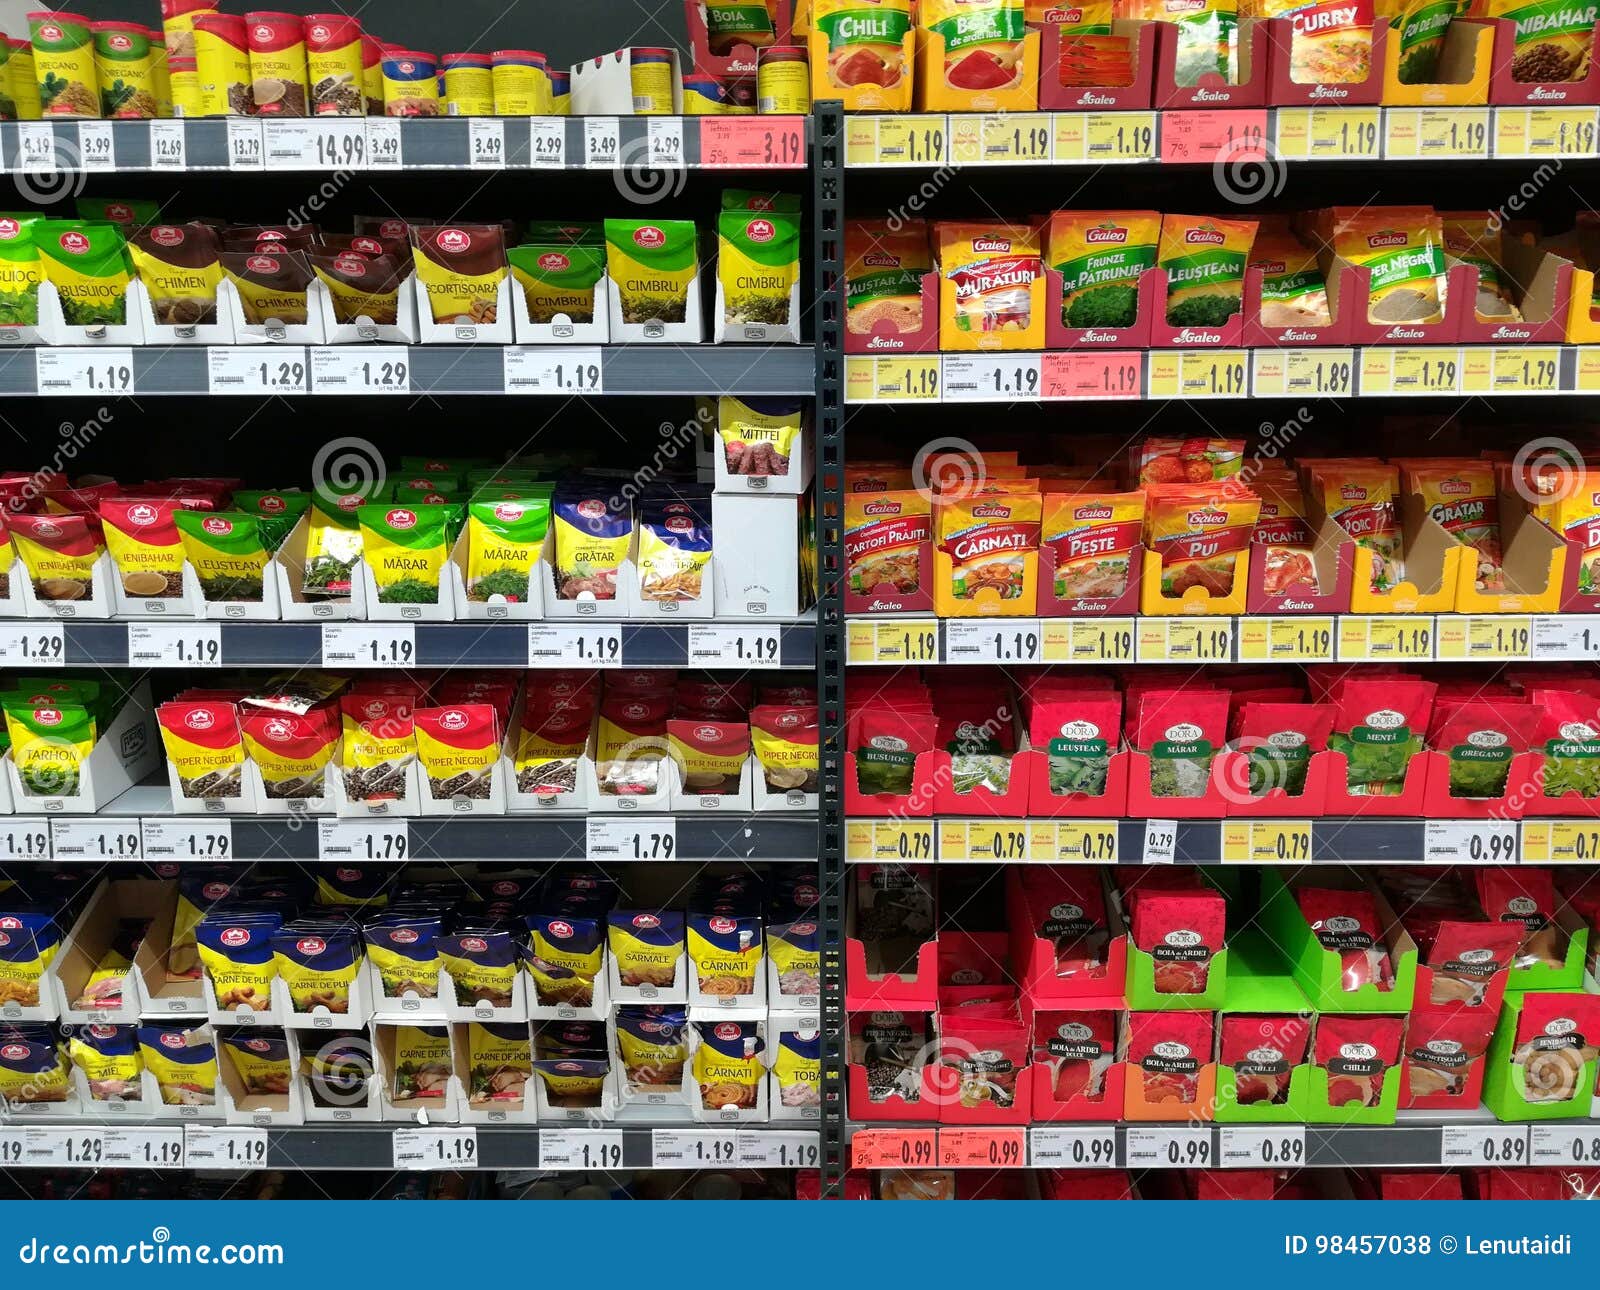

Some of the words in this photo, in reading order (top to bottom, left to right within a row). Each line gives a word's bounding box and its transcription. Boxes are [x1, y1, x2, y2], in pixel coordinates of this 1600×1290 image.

[713, 10, 744, 22] BOIA
[1047, 11, 1080, 23] Galeo
[1292, 7, 1358, 34] CURRY
[1515, 7, 1599, 37] NIBAHAR
[839, 17, 887, 37] CHILI
[85, 138, 110, 153] 3.99
[372, 138, 398, 154] 3.49
[475, 138, 501, 154] 3.49
[535, 138, 561, 154] 2.99
[590, 138, 616, 153] 3.49
[654, 137, 679, 153] 2.99
[908, 130, 942, 162] 1.19
[1013, 128, 1048, 155] 1.19
[1117, 127, 1151, 154] 1.19
[1227, 125, 1261, 152] 1.19
[1341, 122, 1376, 154] 1.19
[1451, 122, 1484, 150] 1.19
[1560, 121, 1595, 153] 1.19
[156, 138, 181, 155] 12.69
[234, 138, 259, 155] 13.79
[316, 134, 364, 165] 14.99
[710, 150, 728, 163] 5%
[764, 132, 799, 163] 3.19
[1171, 143, 1189, 157] 7%
[1088, 230, 1126, 242] Galeo
[1188, 231, 1224, 243] Galeo
[1370, 234, 1406, 245] Galeo
[974, 241, 1010, 252] Galeo
[1087, 253, 1125, 270] FRUNZE
[60, 285, 121, 298] BUSUIOC
[156, 277, 206, 290] CHIMEN
[627, 280, 679, 292] CIMBRU
[736, 276, 785, 290] CIMBRU
[847, 276, 896, 297] MUSTAR
[1064, 279, 1076, 291] DE
[255, 298, 305, 310] CHIMEN
[535, 296, 588, 307] CIMBRU
[877, 338, 904, 349] Galeo
[1186, 332, 1220, 343] Galeo
[87, 366, 131, 389] 1.19
[260, 362, 304, 386] 1.29
[362, 362, 407, 385] 1.29
[555, 364, 600, 388] 1.19
[905, 368, 938, 394] 1.19
[993, 367, 1038, 391] 1.19
[1104, 366, 1136, 391] 1.19
[1211, 364, 1244, 393] 1.19
[1316, 362, 1350, 392] 1.89
[1423, 361, 1456, 386] 1.79
[1522, 360, 1556, 386] 1.79
[1050, 383, 1067, 396] 7%
[740, 428, 780, 441] MITITEI
[866, 503, 900, 514] Galeo
[974, 507, 1009, 518] Galeo
[1076, 508, 1112, 519] Galeo
[1189, 513, 1227, 524] Galeo
[1345, 517, 1371, 534] PORC
[845, 537, 887, 557] CARTOFI
[956, 533, 1028, 560] CÂRNAȚI
[1071, 537, 1116, 558] PEȘTE
[1258, 531, 1304, 544] PICANT
[124, 552, 174, 564] IENIBAHAR
[484, 546, 528, 561] MĂRAR
[1189, 541, 1218, 558] PUI
[384, 556, 428, 570] MĂRAR
[21, 635, 62, 657] 1.29
[176, 639, 219, 661] 1.19
[370, 639, 413, 661] 1.19
[576, 636, 619, 659] 1.19
[735, 636, 778, 659] 1.19
[904, 632, 935, 660] 1.19
[994, 632, 1038, 659] 1.19
[1099, 631, 1131, 659] 1.19
[1196, 630, 1228, 658] 1.19
[1298, 629, 1330, 653] 1.19
[1398, 629, 1429, 653] 1.19
[1497, 628, 1529, 652] 1.19
[27, 749, 78, 761] TARHON
[763, 750, 787, 760] PIPER
[789, 750, 819, 761] NEGRU
[866, 752, 909, 763] BUSUIOC
[1057, 743, 1101, 755] LEUȘTEAN
[1166, 744, 1198, 754] MĂRAR
[1460, 750, 1504, 759] OREGANO
[203, 754, 237, 766] NEGRU
[454, 756, 487, 767] NEGRU
[706, 759, 740, 769] NEGRU
[7, 833, 47, 855] 1.19
[98, 834, 138, 855] 1.19
[188, 834, 229, 855] 1.79
[365, 833, 407, 859] 1.79
[632, 833, 674, 859] 1.79
[900, 832, 930, 859] 0.79
[993, 831, 1025, 858] 0.79
[1083, 832, 1115, 859] 0.79
[1148, 832, 1173, 848] 0.79
[1277, 832, 1309, 860] 0.79
[1470, 834, 1515, 860] 0.99
[1576, 832, 1600, 859] 0.7
[1156, 949, 1175, 957] BOIA
[1182, 949, 1207, 957] ARDEI
[242, 976, 253, 985] DE
[254, 975, 269, 985] PUI
[332, 981, 348, 990] PUI
[400, 1049, 427, 1059] CARNE
[428, 1050, 440, 1059] DE
[473, 1052, 500, 1062] CARNE
[501, 1052, 512, 1062] DE
[1051, 1043, 1068, 1053] BOIA
[1075, 1046, 1099, 1055] ARDEI
[1146, 1059, 1163, 1068] BOIA
[1171, 1061, 1195, 1070] ARDEI
[1343, 1063, 1371, 1073] CHILLI
[66, 1138, 101, 1161] 1.29
[144, 1143, 181, 1162] 1.19
[227, 1140, 265, 1160] 1.19
[436, 1138, 475, 1159] 1.19
[581, 1144, 621, 1168] 1.19
[696, 1140, 734, 1160] 1.19
[779, 1145, 817, 1166] 1.19
[858, 1152, 873, 1164] 9%
[902, 1140, 931, 1164] 0.99
[944, 1152, 960, 1164] 9%
[989, 1139, 1019, 1164] 0.99
[1073, 1139, 1114, 1163] 0.99
[1168, 1139, 1210, 1164] 0.99
[1262, 1138, 1303, 1163] 0.89
[1483, 1137, 1525, 1161] 0.89
[1572, 1137, 1600, 1160] 0.8
